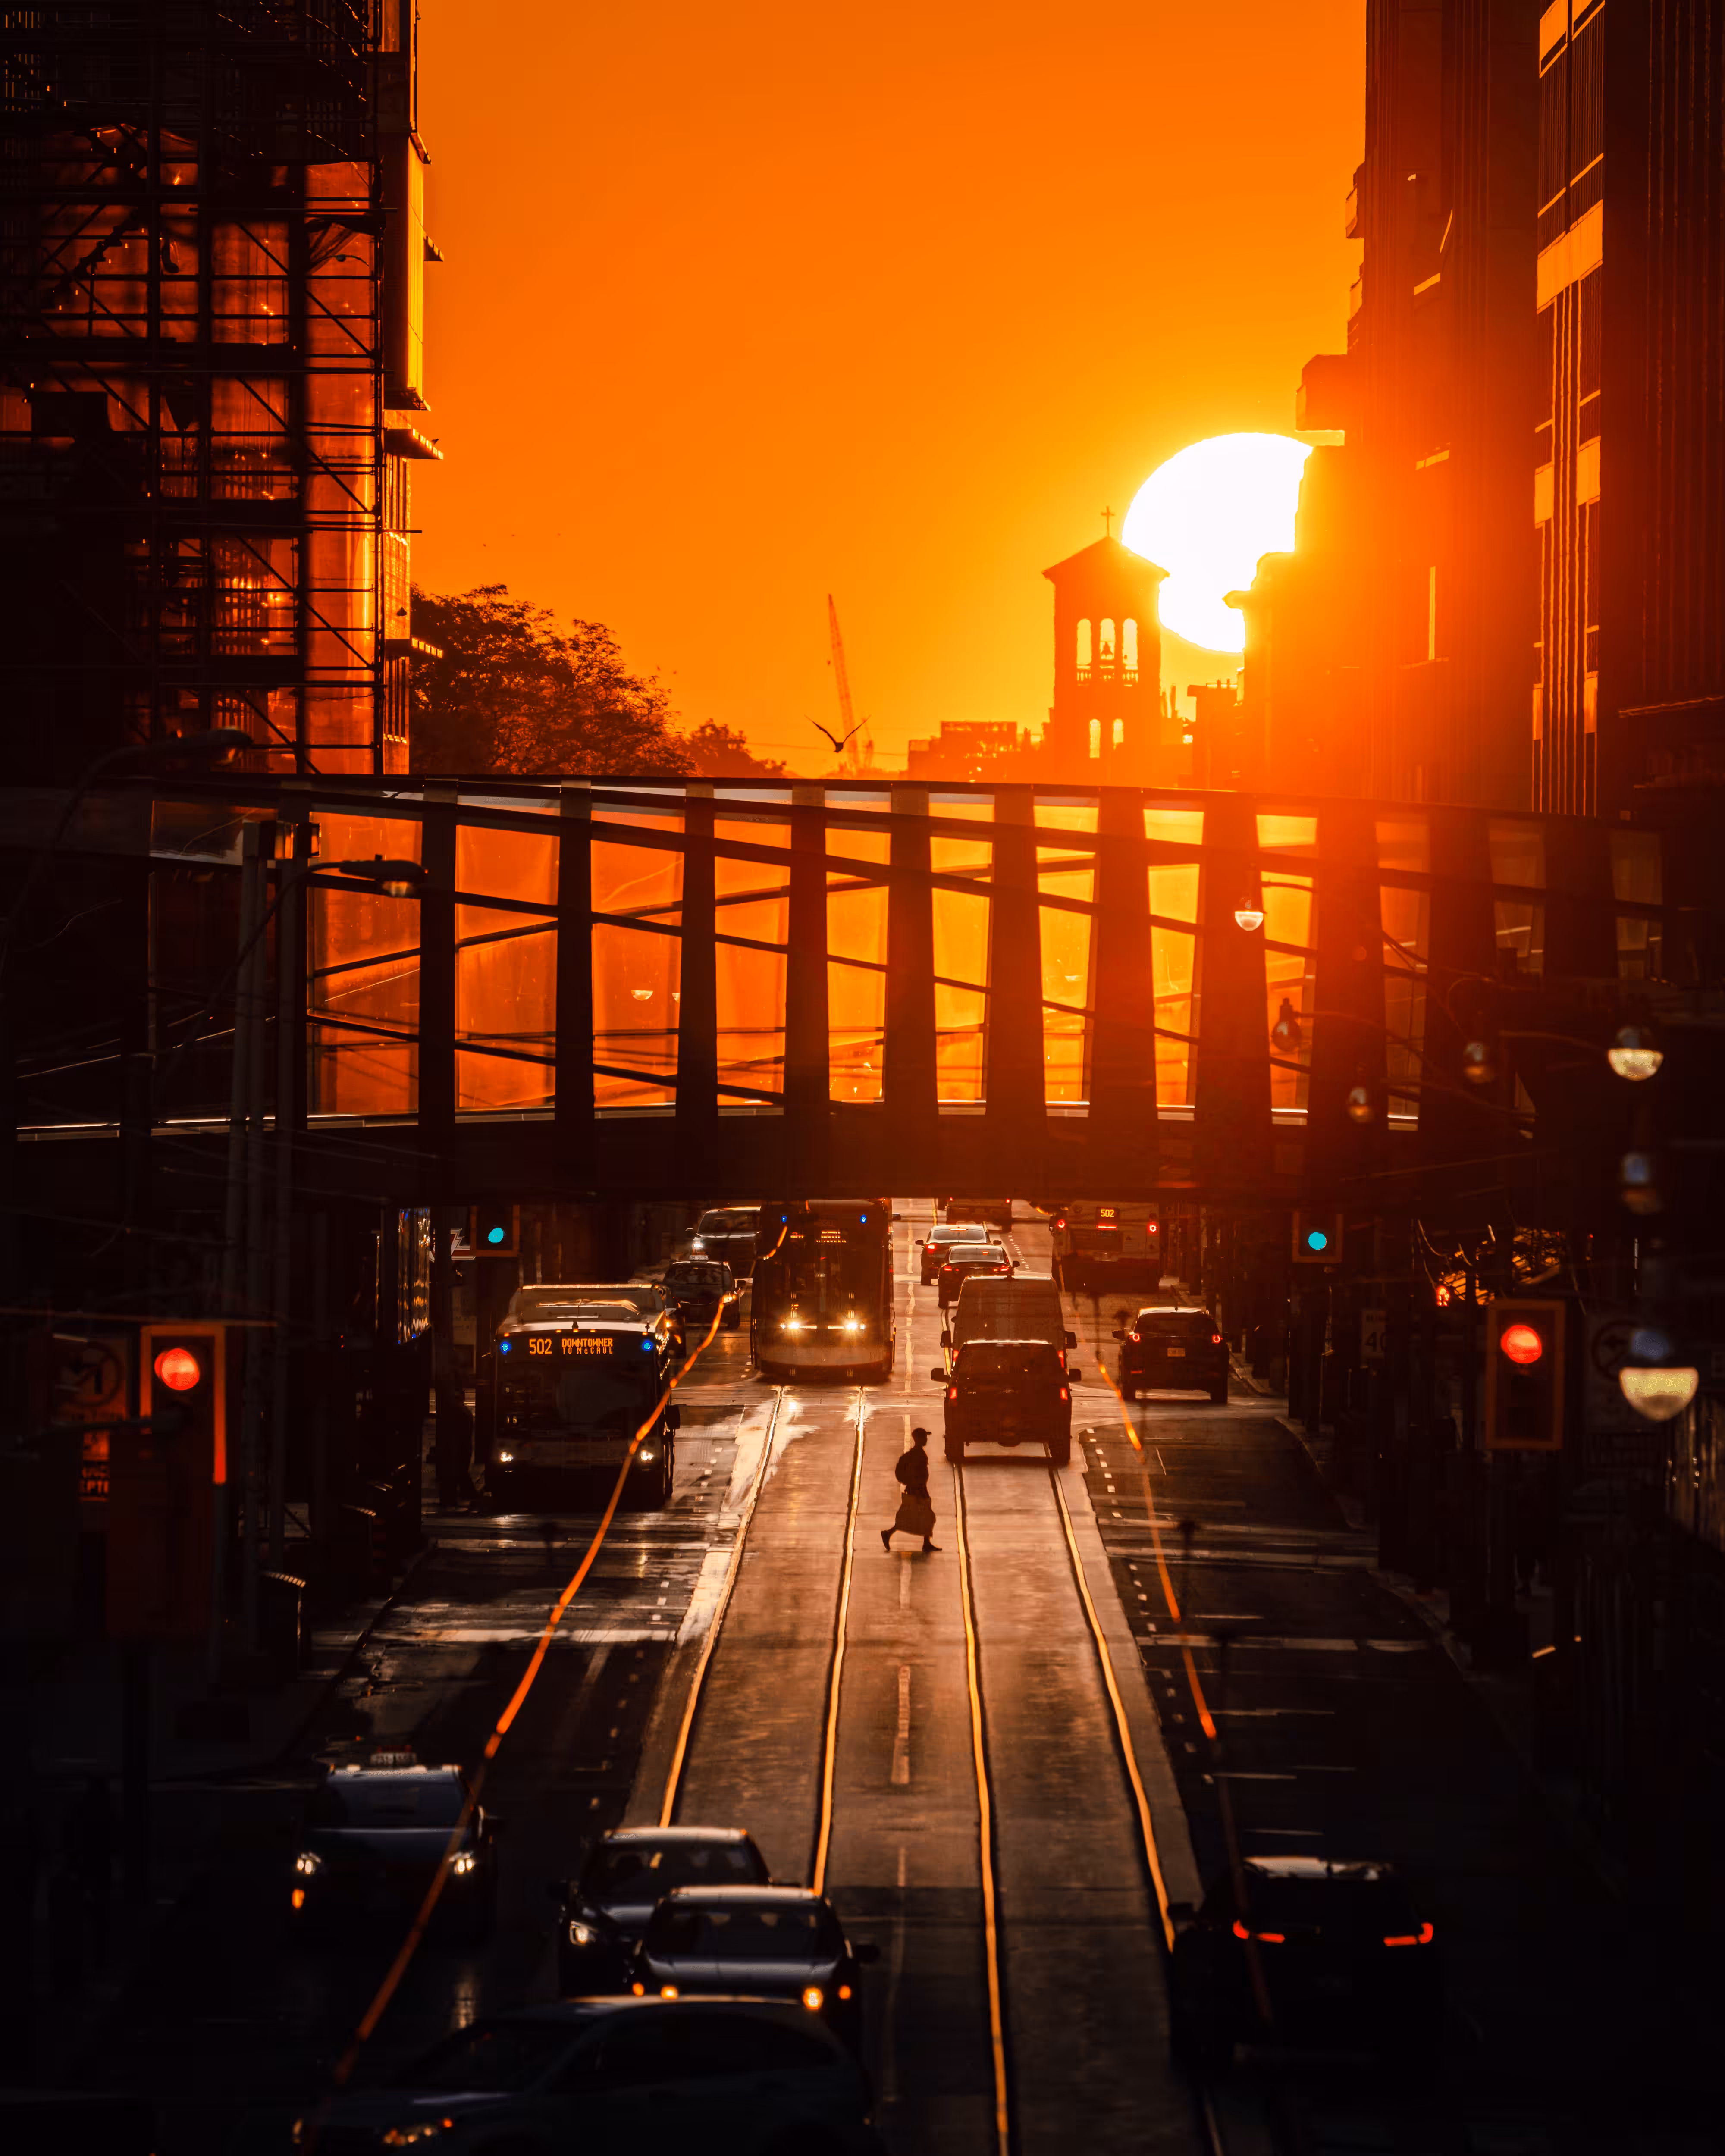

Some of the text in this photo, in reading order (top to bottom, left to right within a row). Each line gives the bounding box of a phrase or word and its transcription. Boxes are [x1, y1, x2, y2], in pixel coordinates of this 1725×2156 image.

[1101, 1209, 1114, 1217] 502
[529, 1338, 552, 1355] 502
[561, 1338, 613, 1347] DOWNTOWNER
